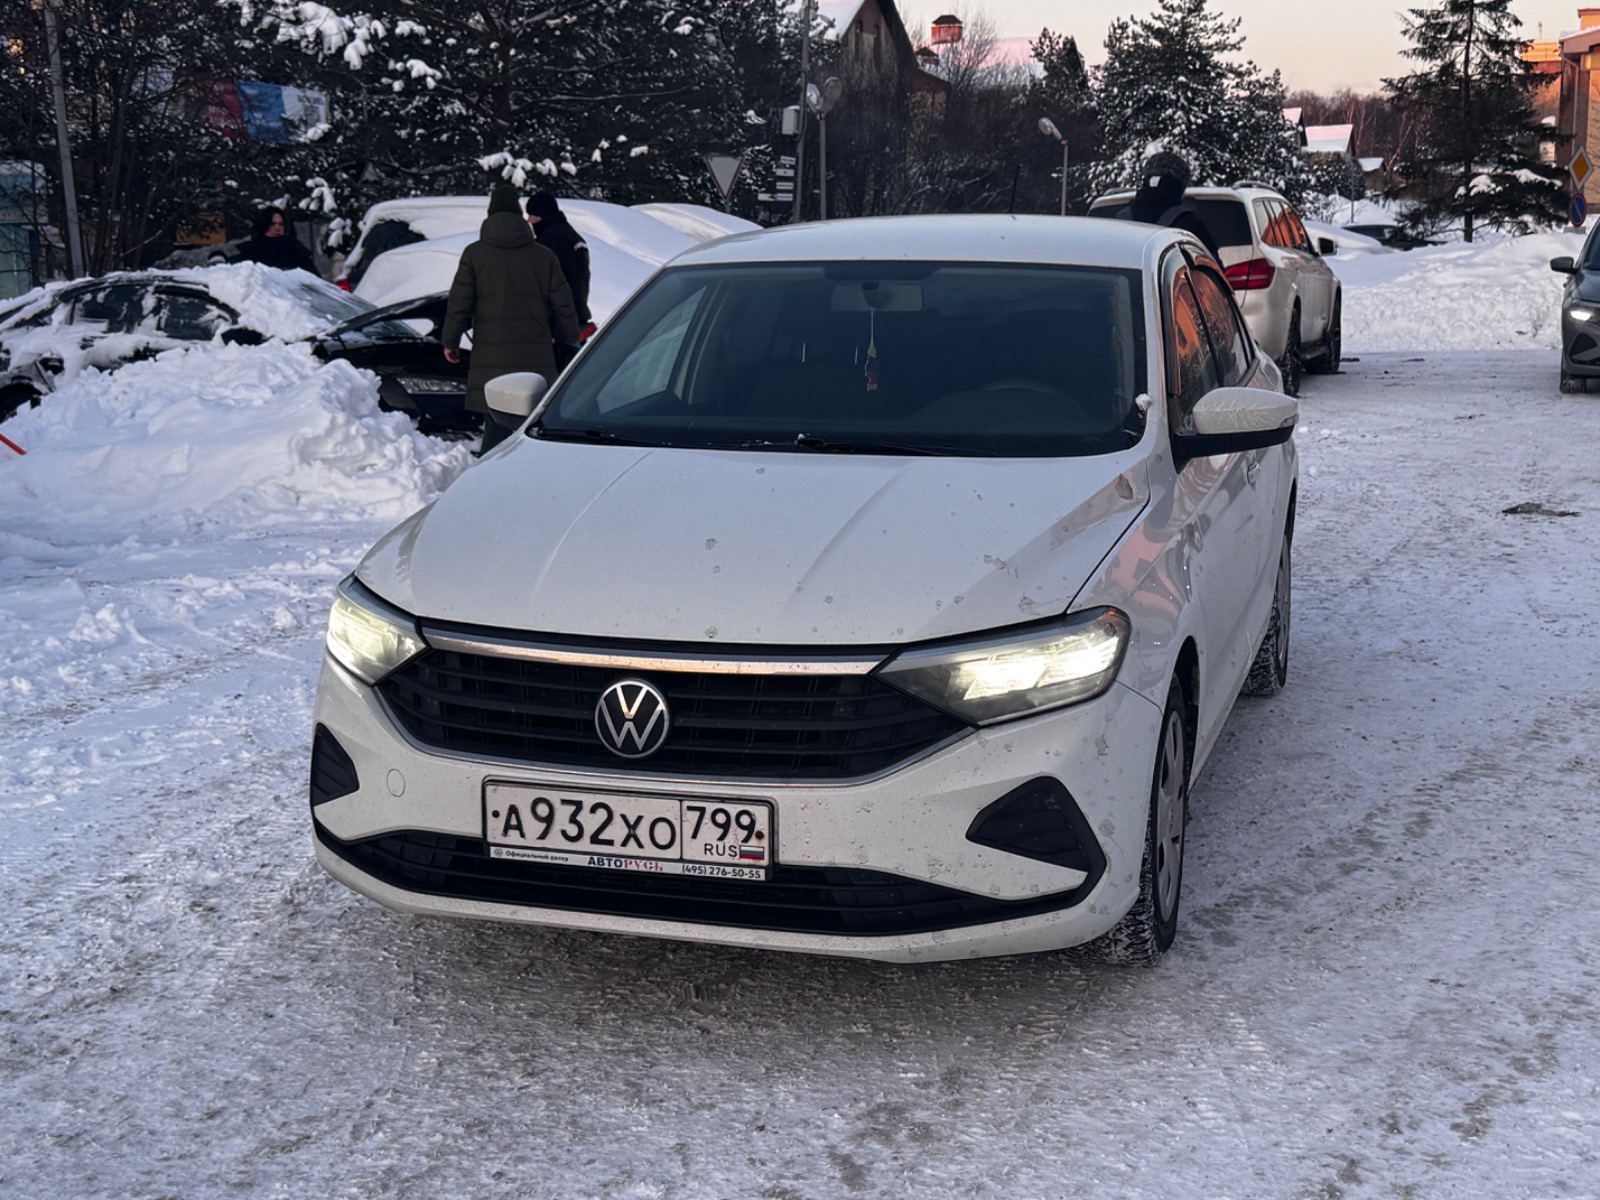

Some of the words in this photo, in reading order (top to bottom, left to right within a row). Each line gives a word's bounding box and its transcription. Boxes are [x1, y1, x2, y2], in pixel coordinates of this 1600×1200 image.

[501, 796, 677, 851] А932ХО
[686, 805, 756, 844] 799
[703, 843, 738, 857] RUS
[682, 864, 707, 875] (495)
[709, 866, 761, 879] 276-50-55
